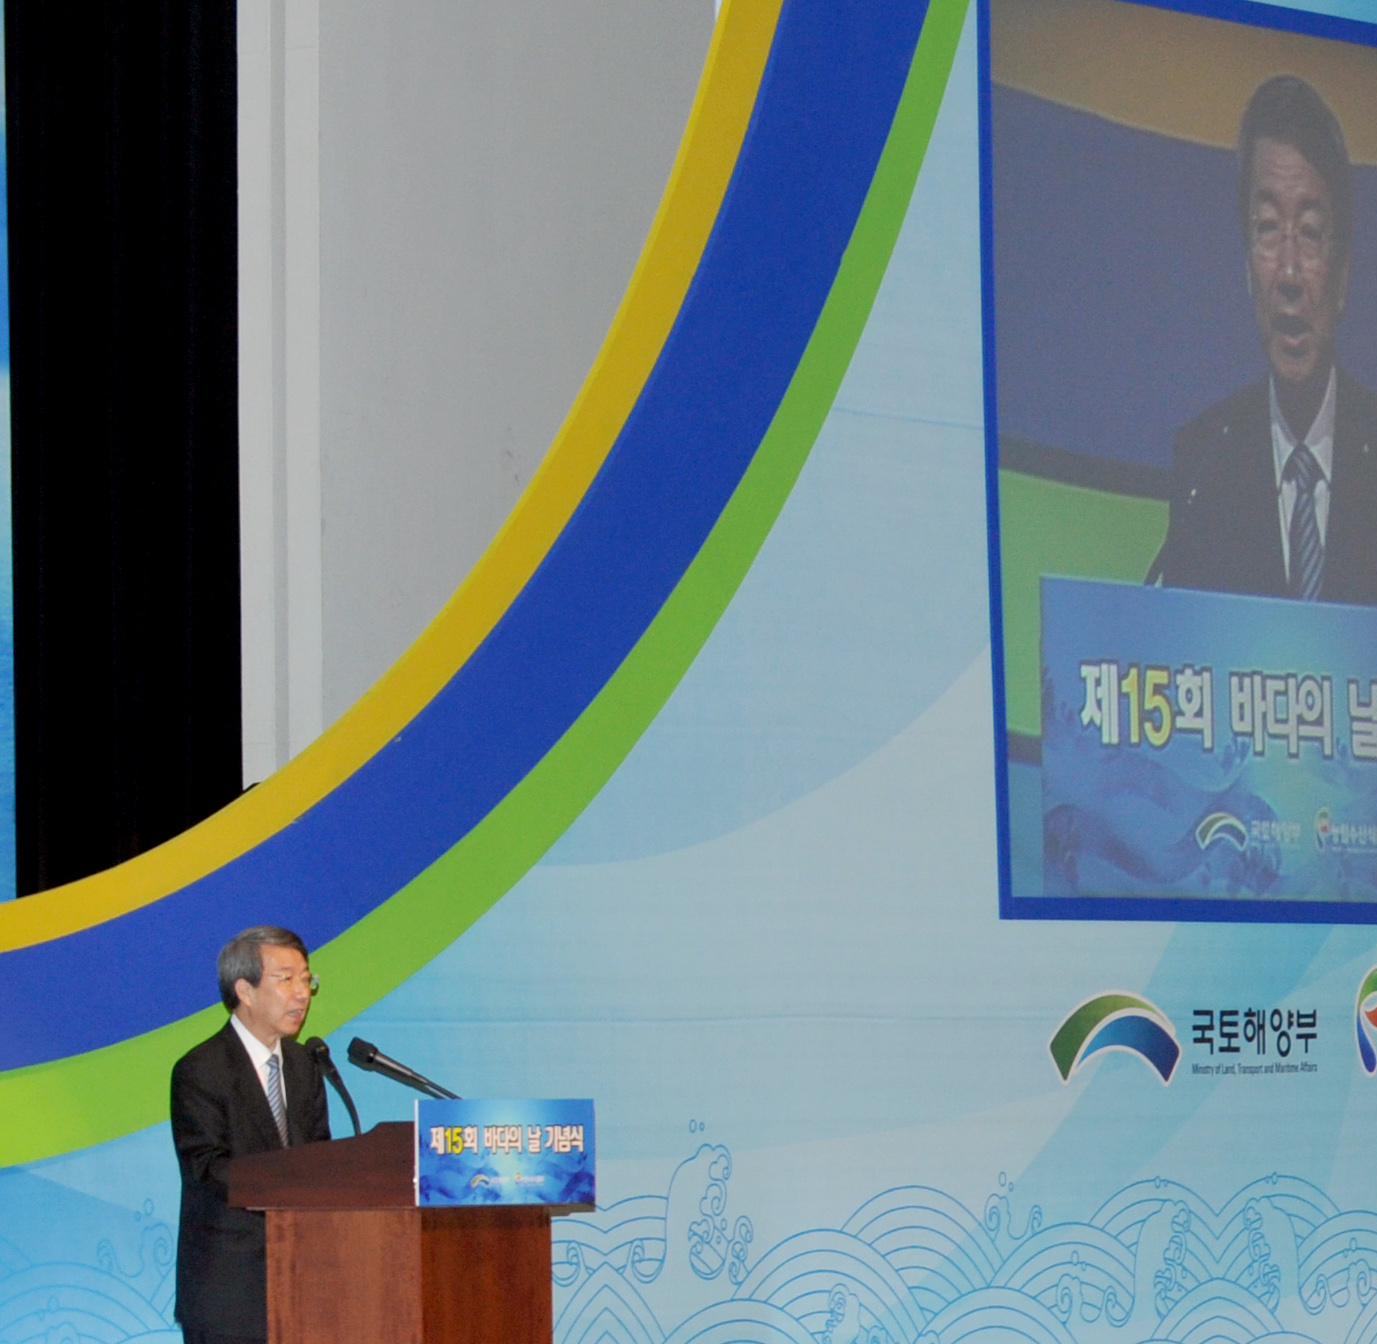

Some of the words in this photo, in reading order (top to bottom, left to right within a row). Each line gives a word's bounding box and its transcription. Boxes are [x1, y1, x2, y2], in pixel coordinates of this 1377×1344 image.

[1078, 660, 1215, 754] 제15회
[1229, 670, 1334, 760] 바다의
[1192, 1007, 1318, 1058] 국토해양부
[429, 1125, 479, 1155] 제15회
[483, 1125, 522, 1154] 바다의
[527, 1125, 542, 1153] 날
[544, 1124, 584, 1154] 기념식
